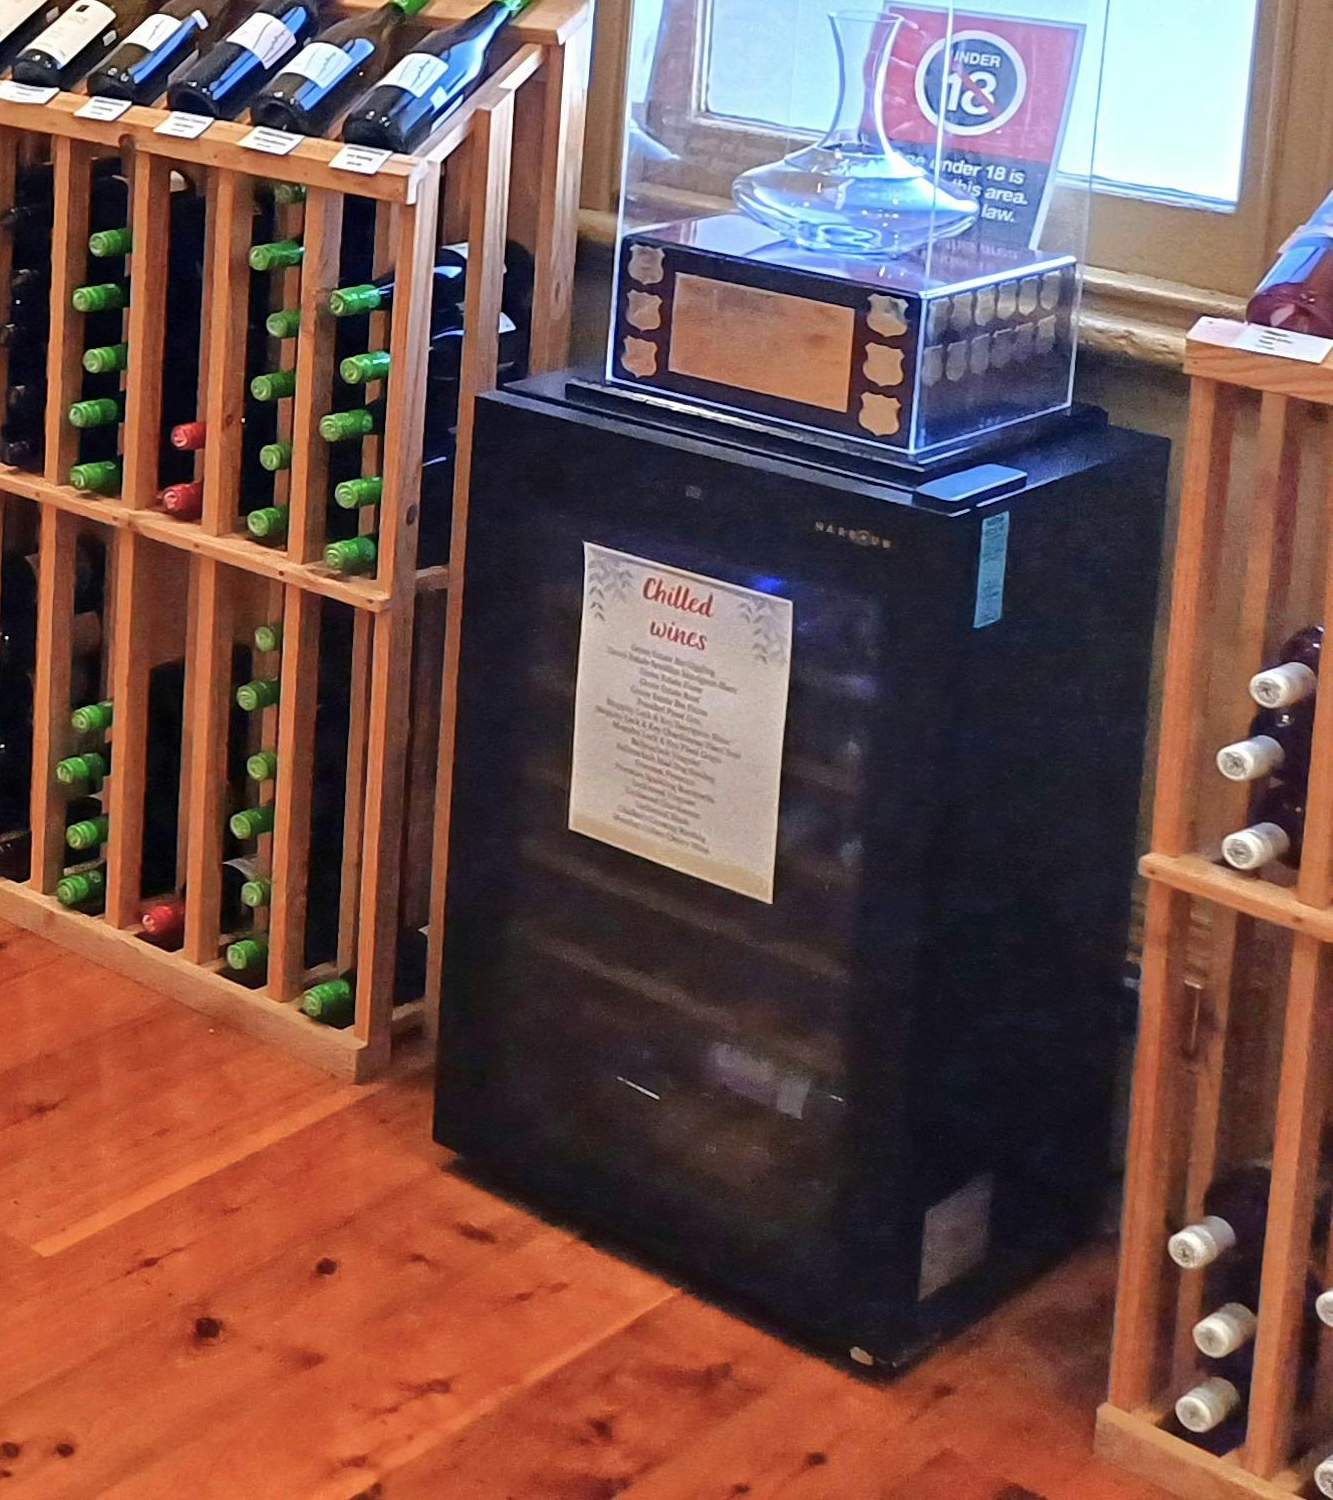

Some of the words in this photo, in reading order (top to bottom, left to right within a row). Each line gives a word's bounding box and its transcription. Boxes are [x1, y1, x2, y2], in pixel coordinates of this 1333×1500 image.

[985, 164, 1006, 181] 18
[1008, 168, 1026, 185] is
[984, 187, 1028, 205] area.
[981, 204, 1015, 222] law.
[643, 577, 715, 617] Chilled
[649, 617, 708, 651] wines
